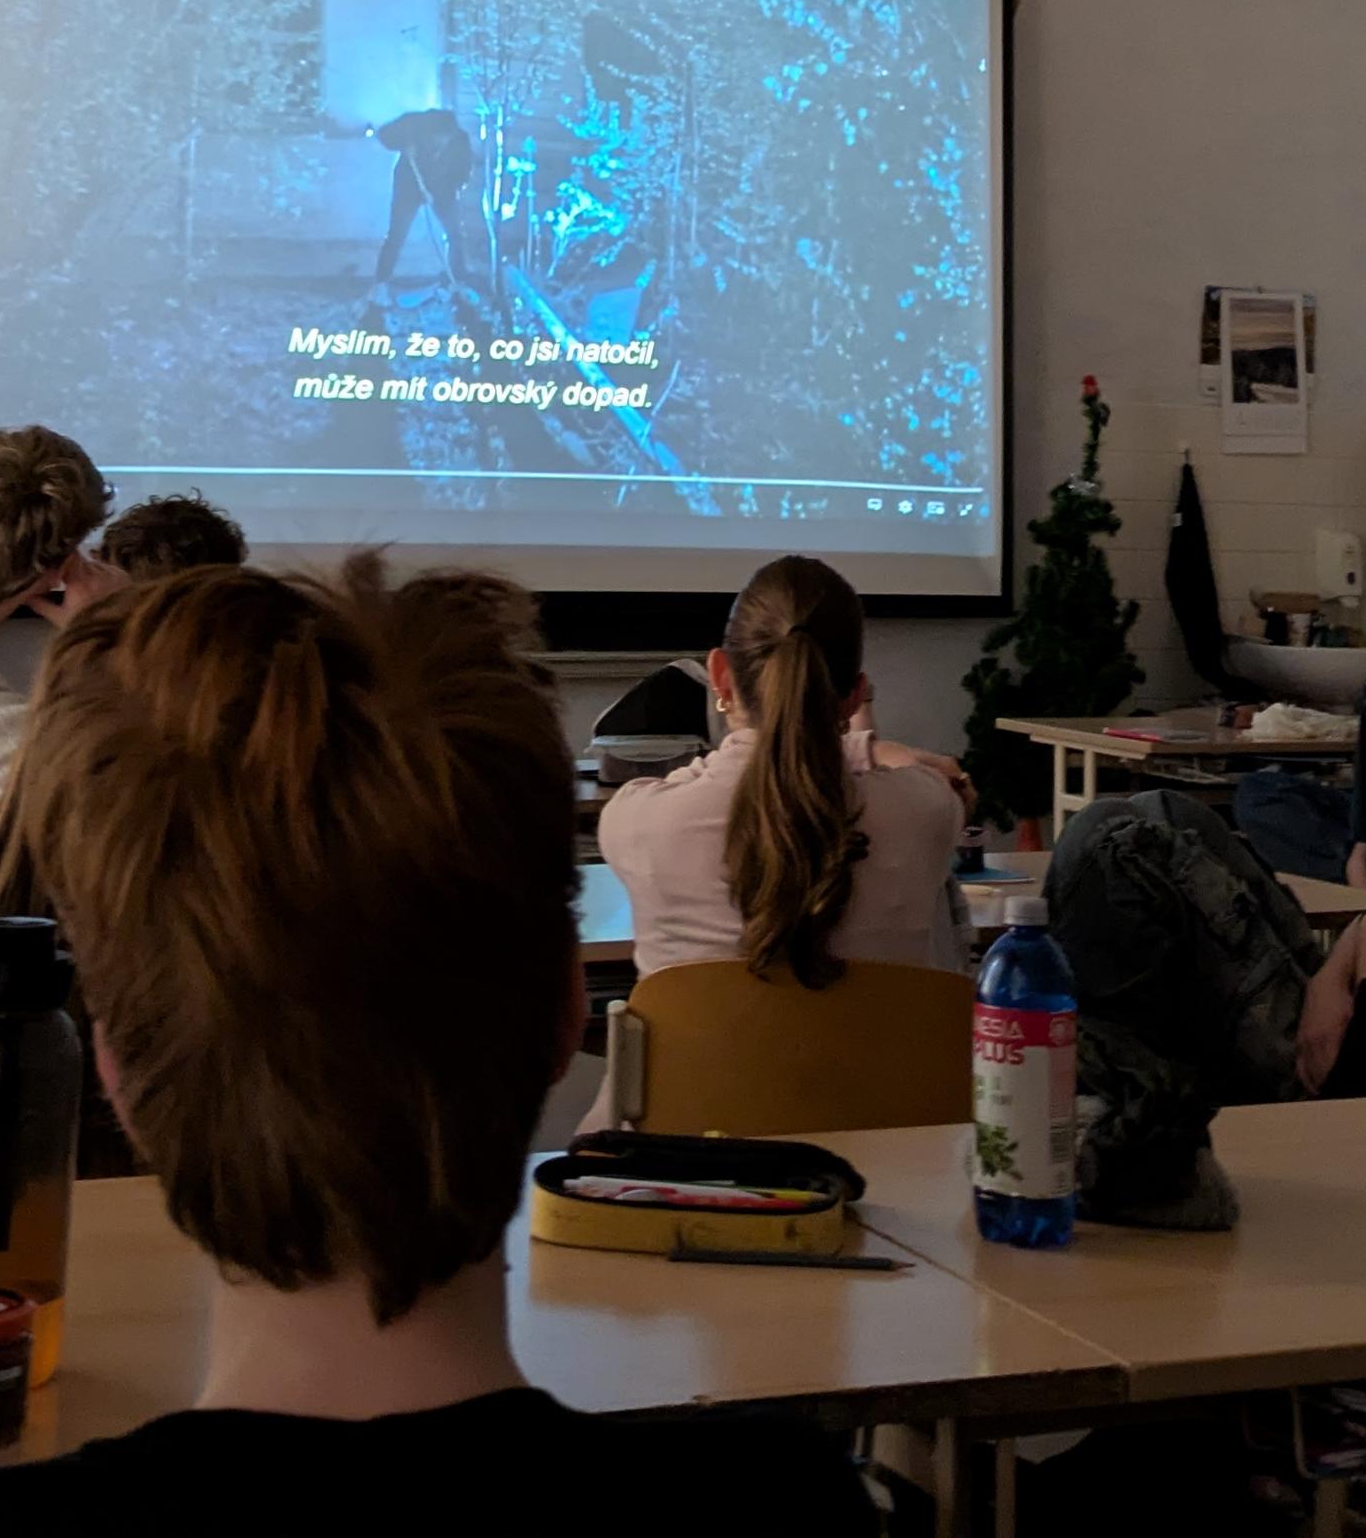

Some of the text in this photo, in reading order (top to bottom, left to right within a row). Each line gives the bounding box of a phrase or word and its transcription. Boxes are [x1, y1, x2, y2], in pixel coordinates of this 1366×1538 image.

[288, 327, 659, 369] Myslím, že to, co jsi natočil,
[293, 373, 652, 412] může mít obrovský dopad.
